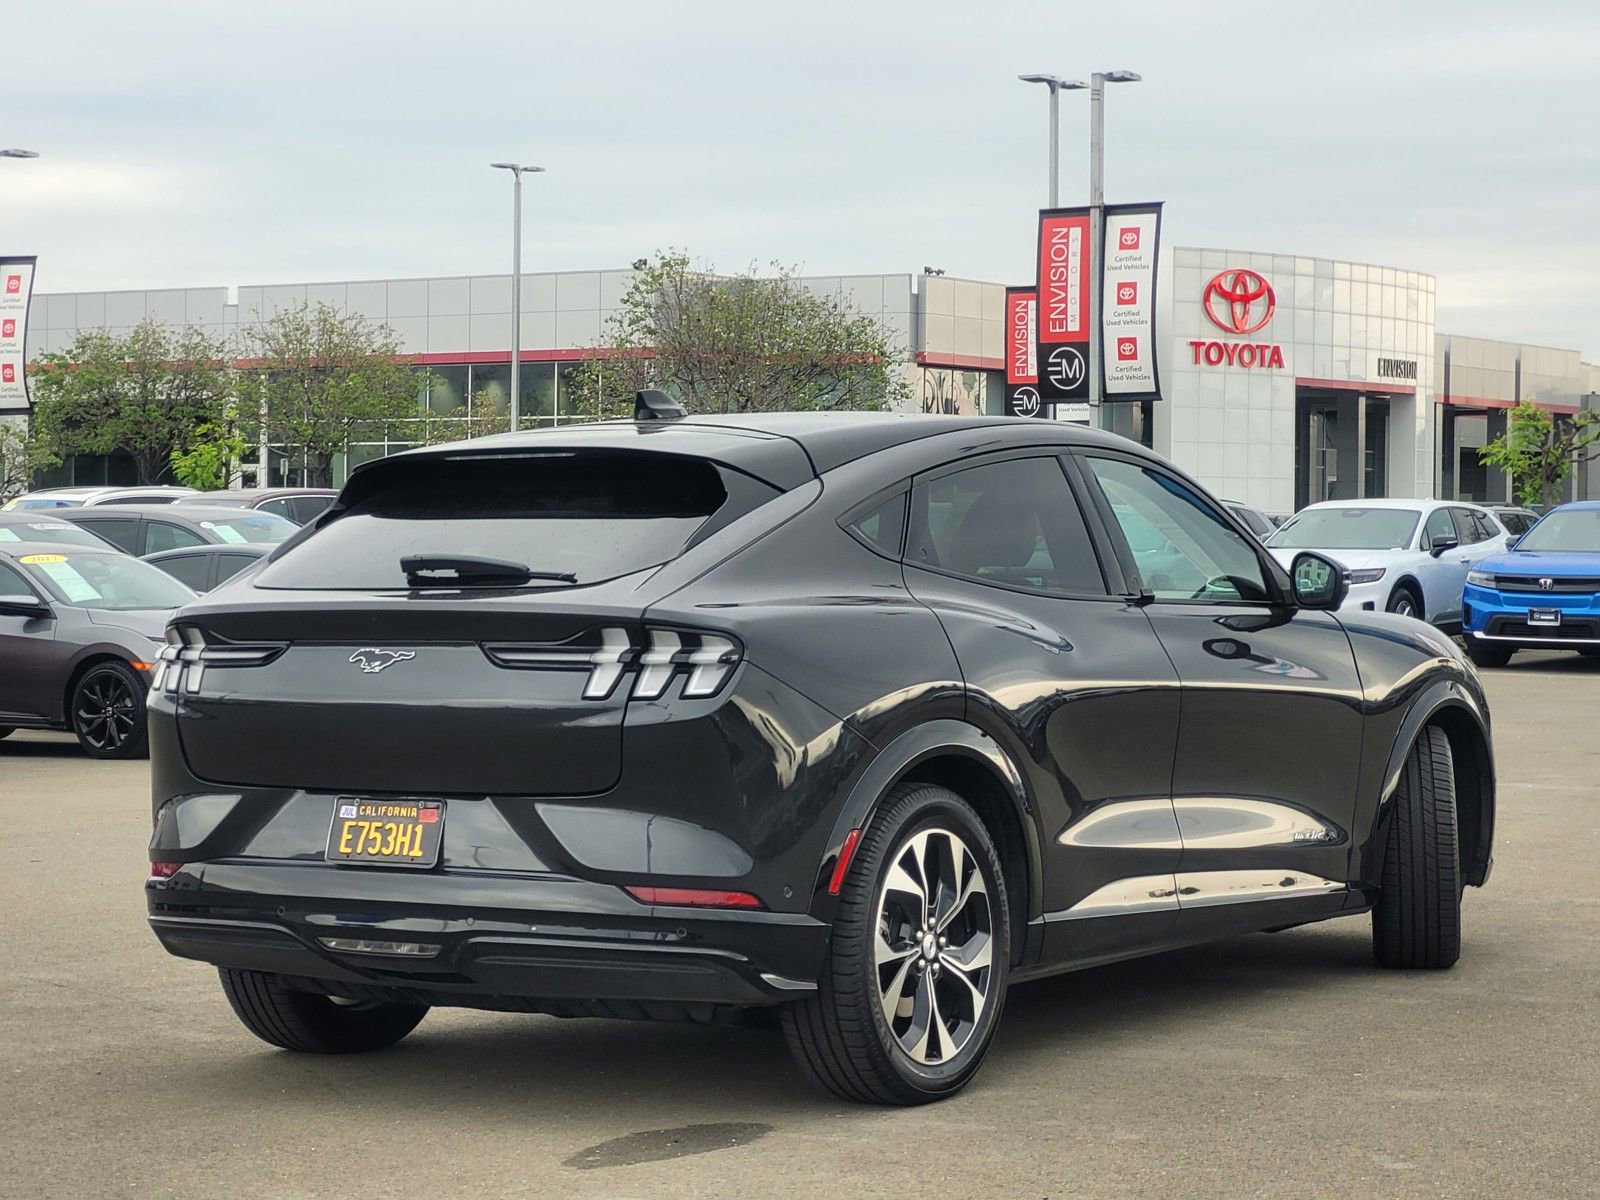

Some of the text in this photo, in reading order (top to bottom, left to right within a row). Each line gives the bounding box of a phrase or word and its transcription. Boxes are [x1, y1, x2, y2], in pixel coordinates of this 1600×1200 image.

[1124, 262, 1149, 270] Vehicles
[1049, 227, 1069, 333] ENVISION
[1071, 236, 1079, 323] MOTORS
[1122, 318, 1148, 326] Vehicles
[1015, 300, 1028, 377] ENVISION
[1189, 341, 1285, 369] TOYOTA
[1125, 373, 1151, 381] Vehicles
[1377, 357, 1417, 380] ENVISION
[359, 805, 417, 818] CALIFORNIA
[338, 821, 423, 857] E753H1
